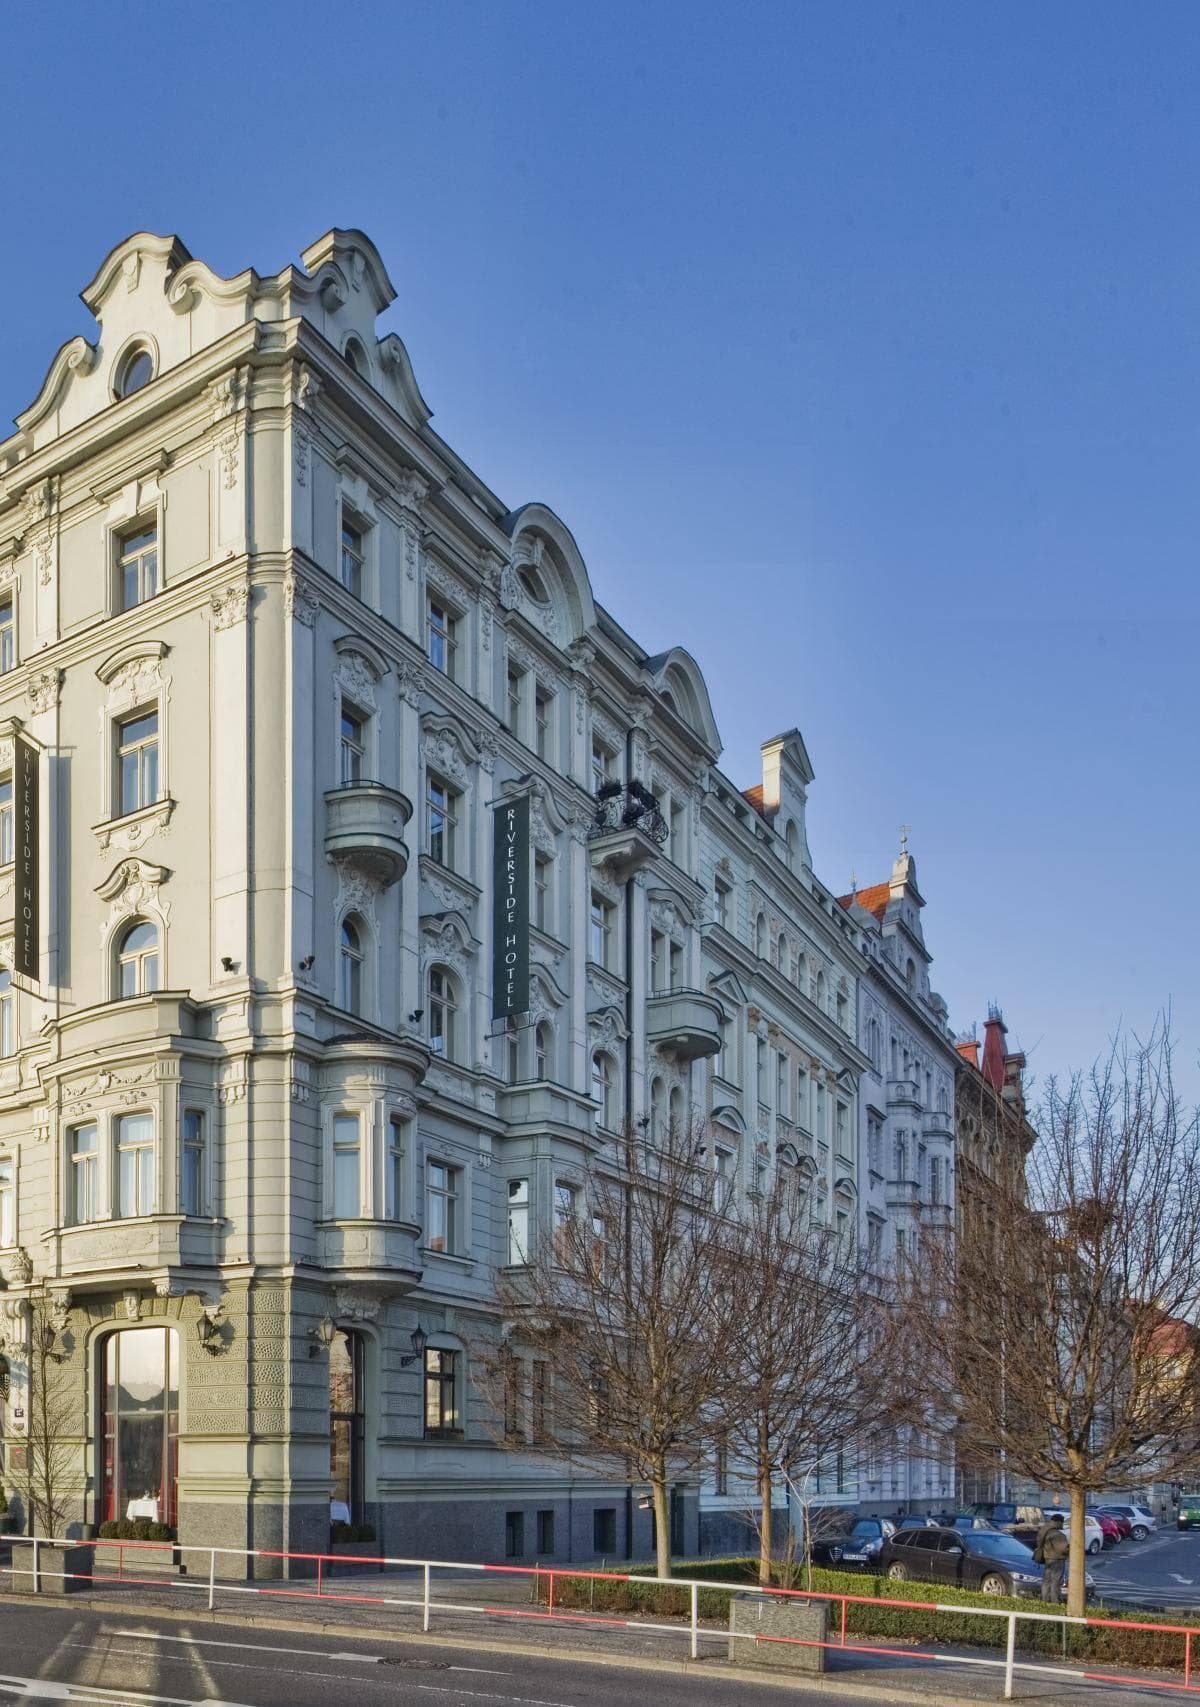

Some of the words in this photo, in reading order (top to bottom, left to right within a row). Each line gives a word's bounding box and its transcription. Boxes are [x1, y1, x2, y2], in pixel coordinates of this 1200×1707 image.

[23, 748, 31, 874] RIVERSIDE
[506, 809, 515, 923] RIVERSIDE
[23, 886, 31, 967] HOTEL
[505, 935, 516, 1007] HOTEL
